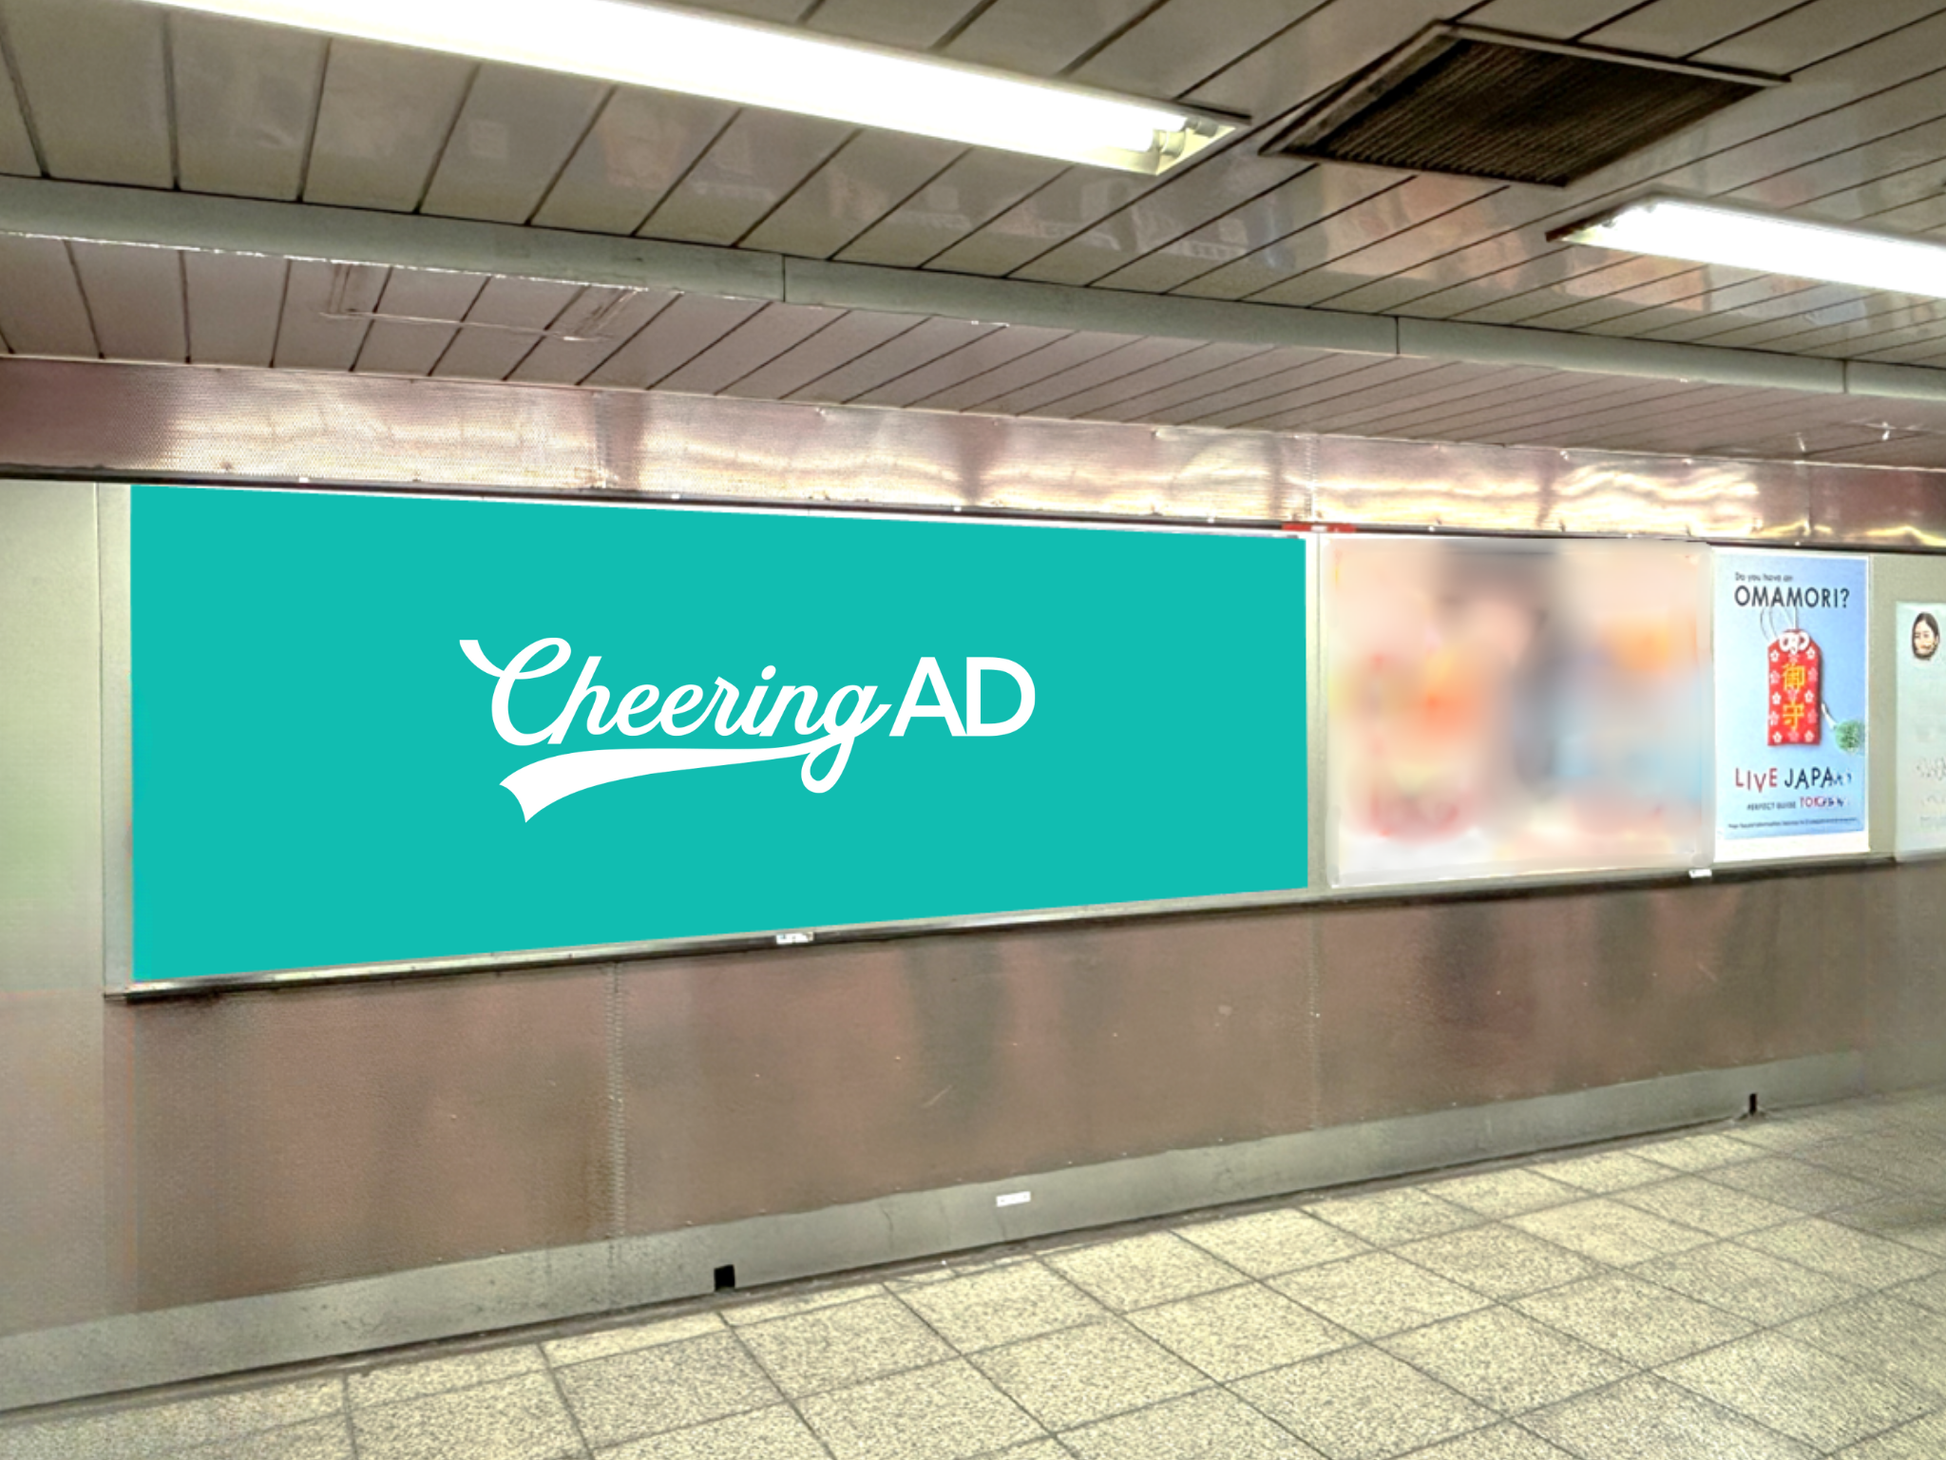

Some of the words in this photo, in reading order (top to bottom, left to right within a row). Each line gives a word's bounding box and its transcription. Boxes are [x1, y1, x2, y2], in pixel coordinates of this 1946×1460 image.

[1734, 571, 1746, 582] Do
[1748, 573, 1761, 583] you
[1762, 572, 1782, 582] have
[1734, 585, 1850, 608] OMAMORI?
[1782, 662, 1805, 731] 御守
[1735, 767, 1778, 793] LIVE
